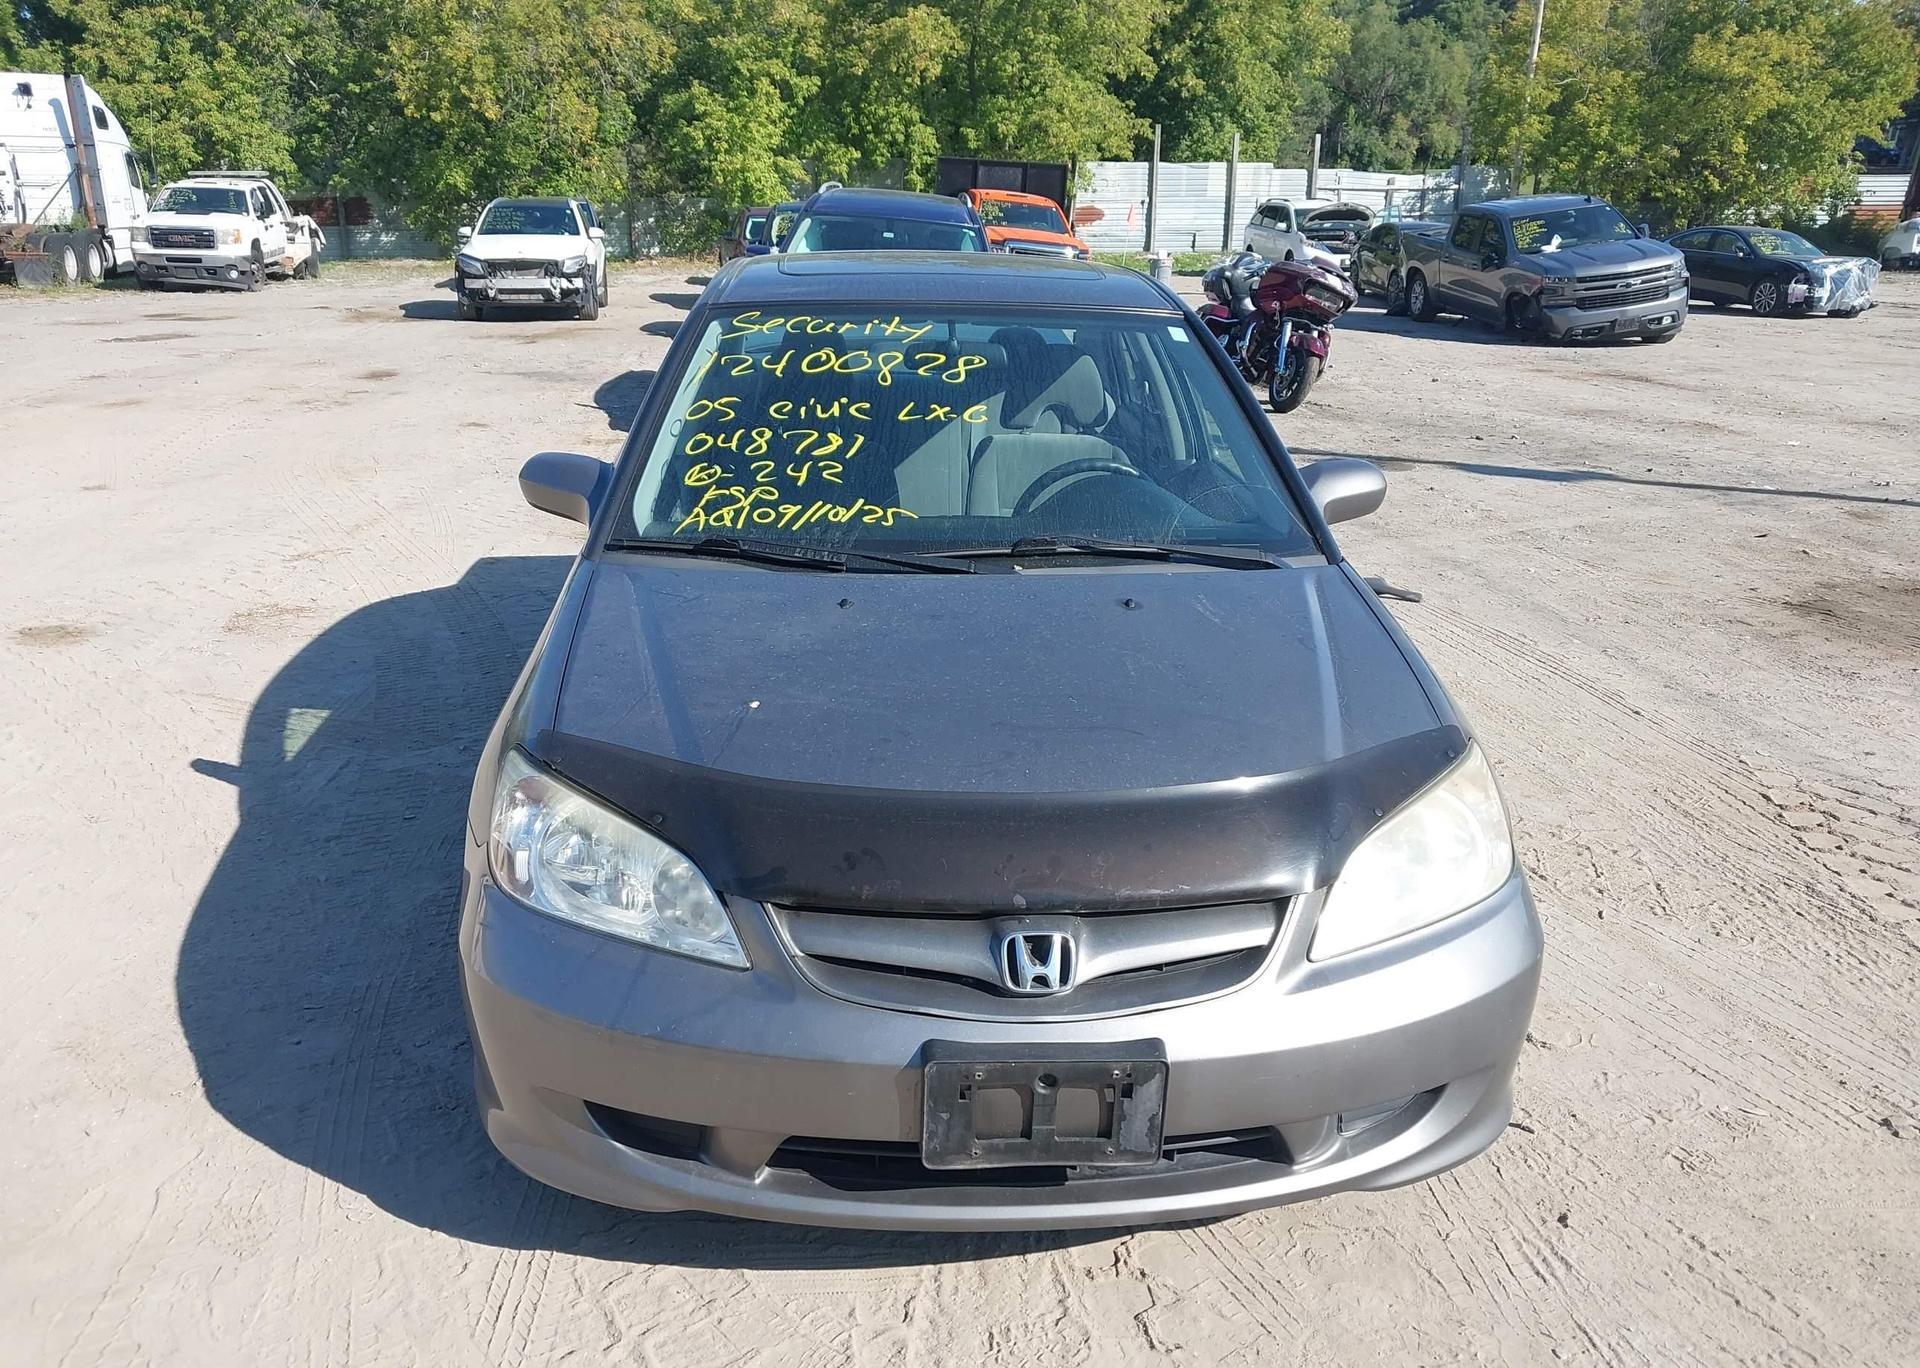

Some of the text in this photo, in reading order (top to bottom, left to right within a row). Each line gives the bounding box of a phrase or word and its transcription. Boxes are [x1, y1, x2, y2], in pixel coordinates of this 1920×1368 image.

[168, 234, 195, 242] GMC
[720, 311, 933, 343] Security
[693, 346, 987, 386] 12400828
[685, 396, 742, 421] 05
[750, 460, 844, 487] 242
